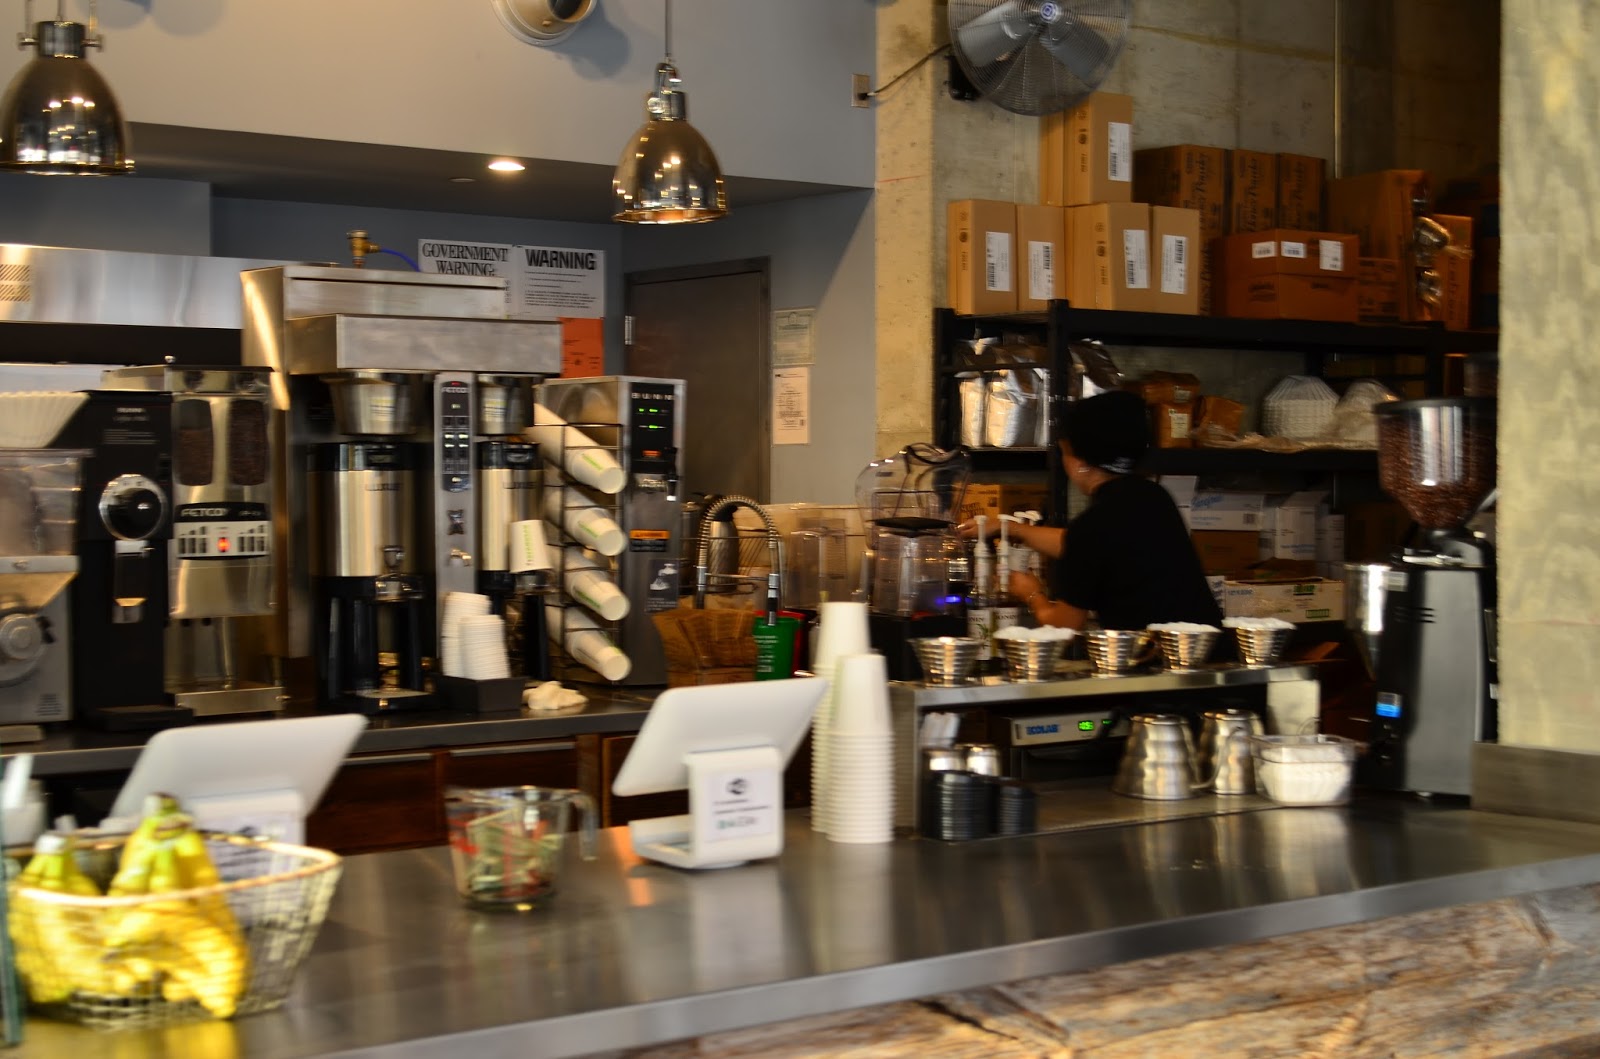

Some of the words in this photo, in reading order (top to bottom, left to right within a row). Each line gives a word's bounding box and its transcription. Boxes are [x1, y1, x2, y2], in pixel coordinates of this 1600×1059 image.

[422, 242, 508, 262] GOVERNMENT
[525, 249, 597, 270] WARNING
[181, 508, 227, 517] FETCO
